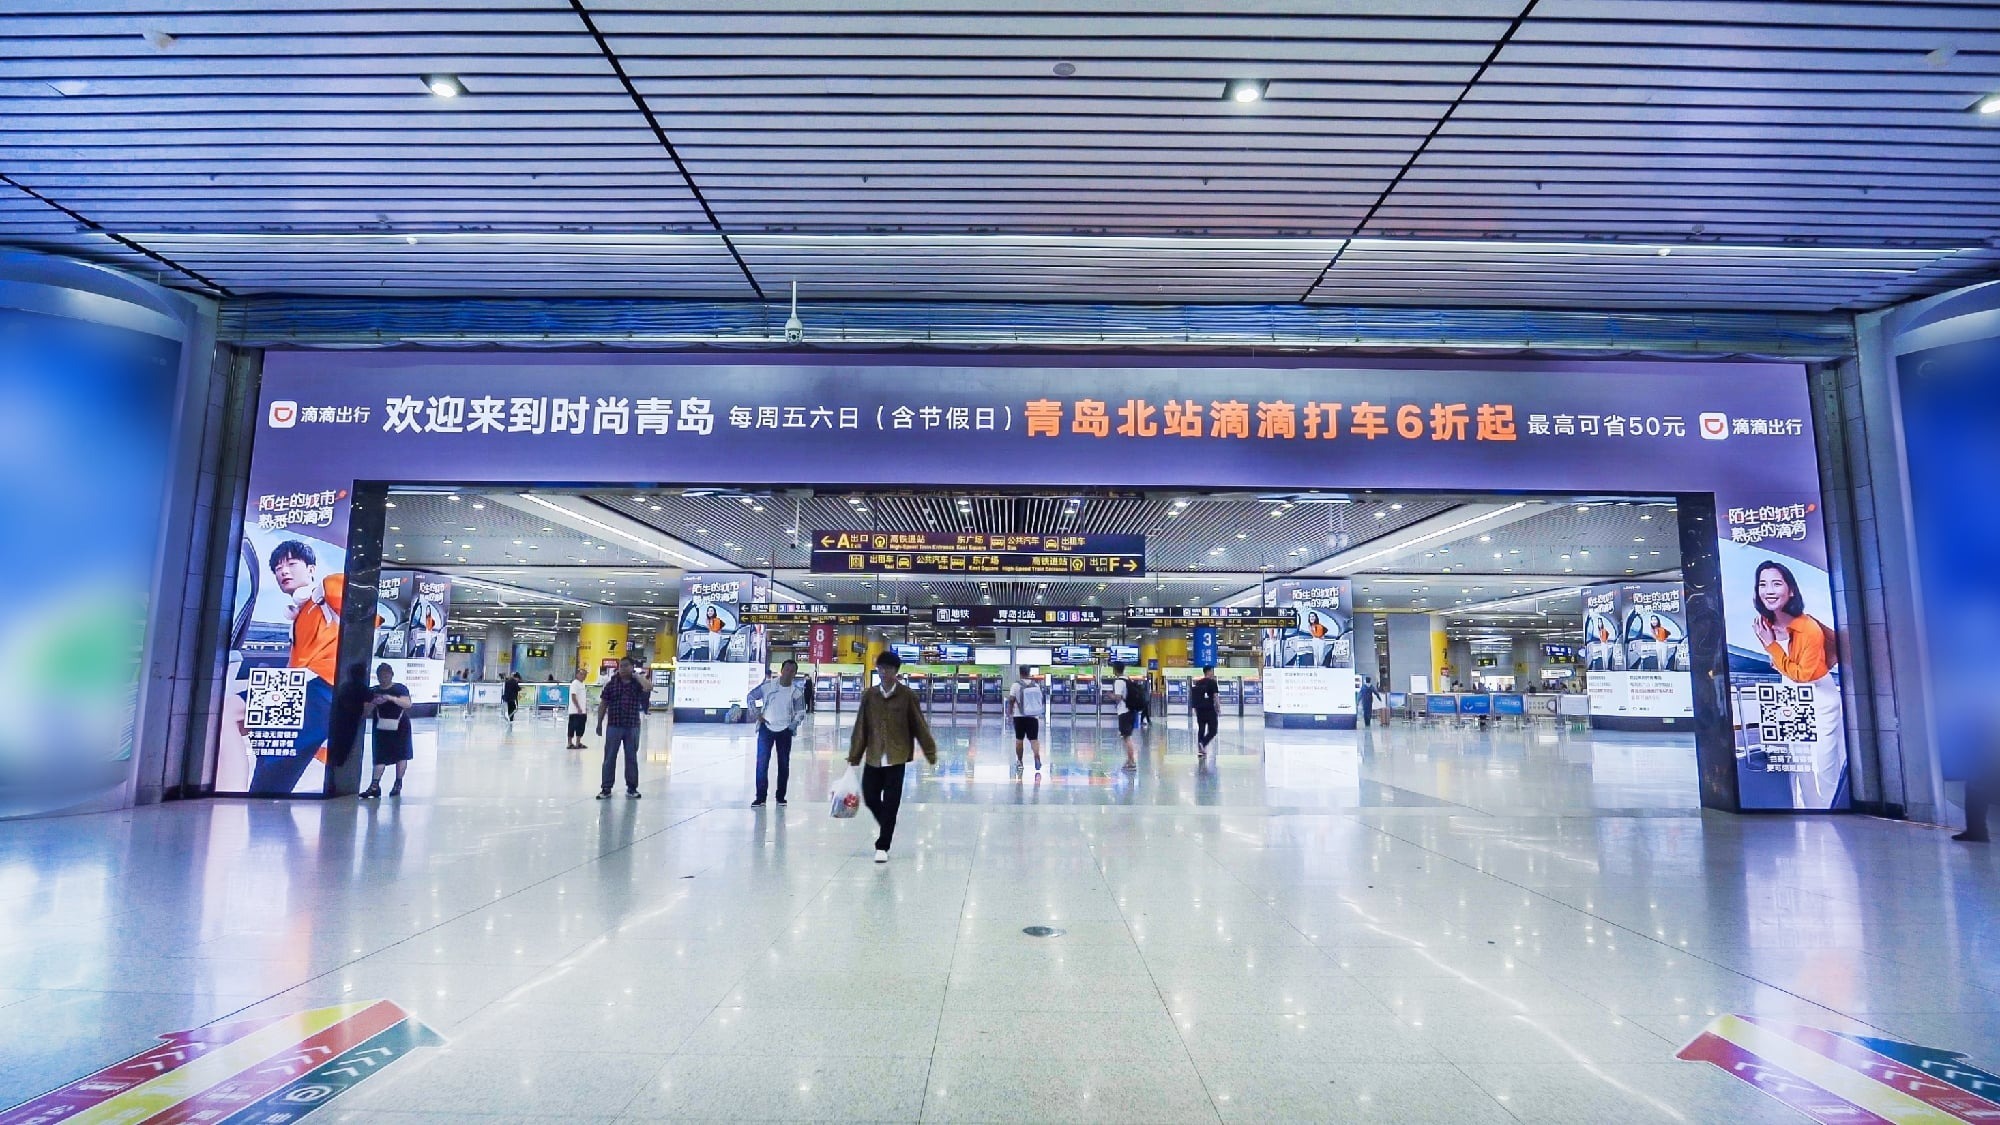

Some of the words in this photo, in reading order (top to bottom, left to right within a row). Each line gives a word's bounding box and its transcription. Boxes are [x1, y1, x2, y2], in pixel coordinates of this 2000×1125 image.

[301, 405, 371, 425] 滴滴出行
[382, 395, 715, 436] 欢迎来到时尚青岛
[1024, 399, 1517, 441] 青岛北站滴滴打车6折起
[1527, 413, 1686, 438] 最高可省50元
[1732, 418, 1803, 436] 滴滴出行
[259, 490, 335, 512] 陌生的城市
[258, 506, 333, 532] 熟悉的滴滴
[1728, 504, 1805, 525] 陌生的城市
[850, 534, 869, 542] 出口
[1731, 520, 1807, 546] 熟悉的滴滴
[837, 533, 850, 548] A
[890, 535, 926, 544] 高铁进站
[957, 535, 984, 544] 东广场
[1007, 536, 1040, 545] 公共汽车
[1061, 537, 1086, 546] 出租车
[870, 554, 895, 563] 出租车
[916, 555, 949, 564] 公共汽车
[972, 556, 1000, 565] 东广场
[1090, 557, 1108, 566] 出口
[1109, 557, 1120, 572] F
[951, 609, 970, 619] 地铁
[998, 609, 1036, 619] 青岛北站
[816, 628, 825, 642] 8
[1203, 632, 1212, 646] 3
